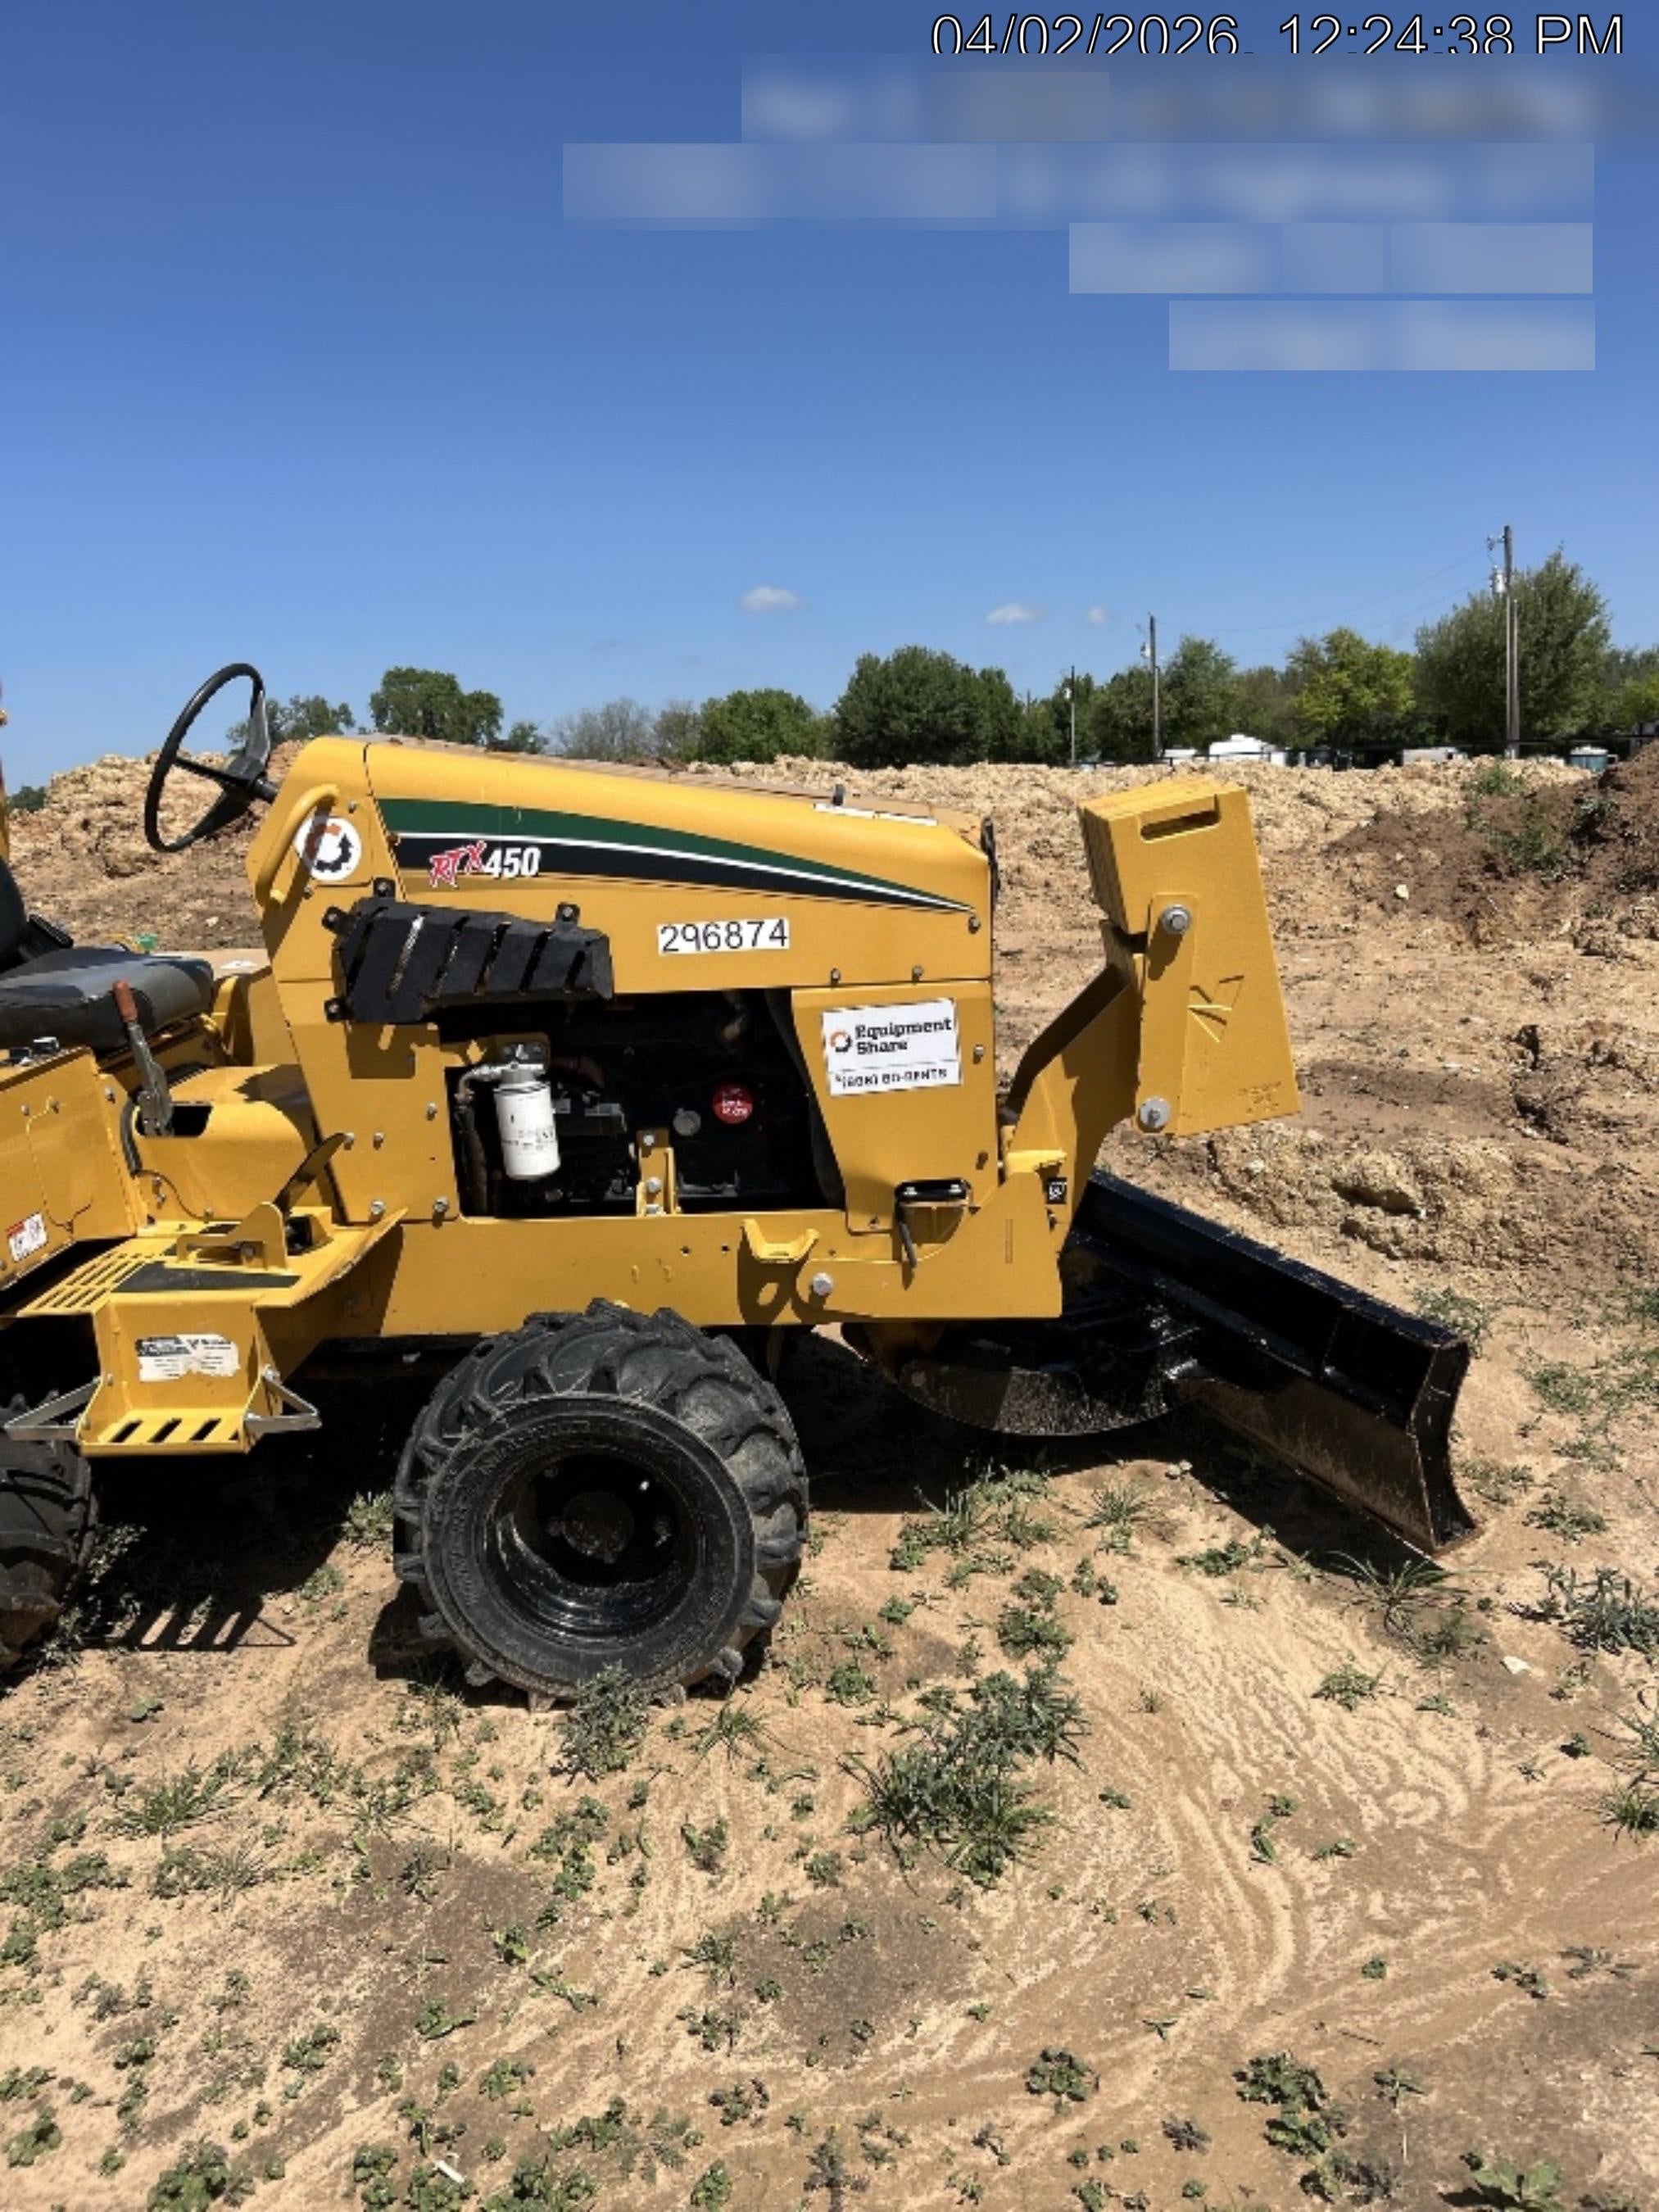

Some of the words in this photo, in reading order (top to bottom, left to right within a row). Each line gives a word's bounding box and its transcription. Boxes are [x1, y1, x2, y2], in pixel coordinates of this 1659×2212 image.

[660, 918, 788, 952] 296874
[854, 1018, 952, 1040] Equipment
[857, 1040, 909, 1055] Share
